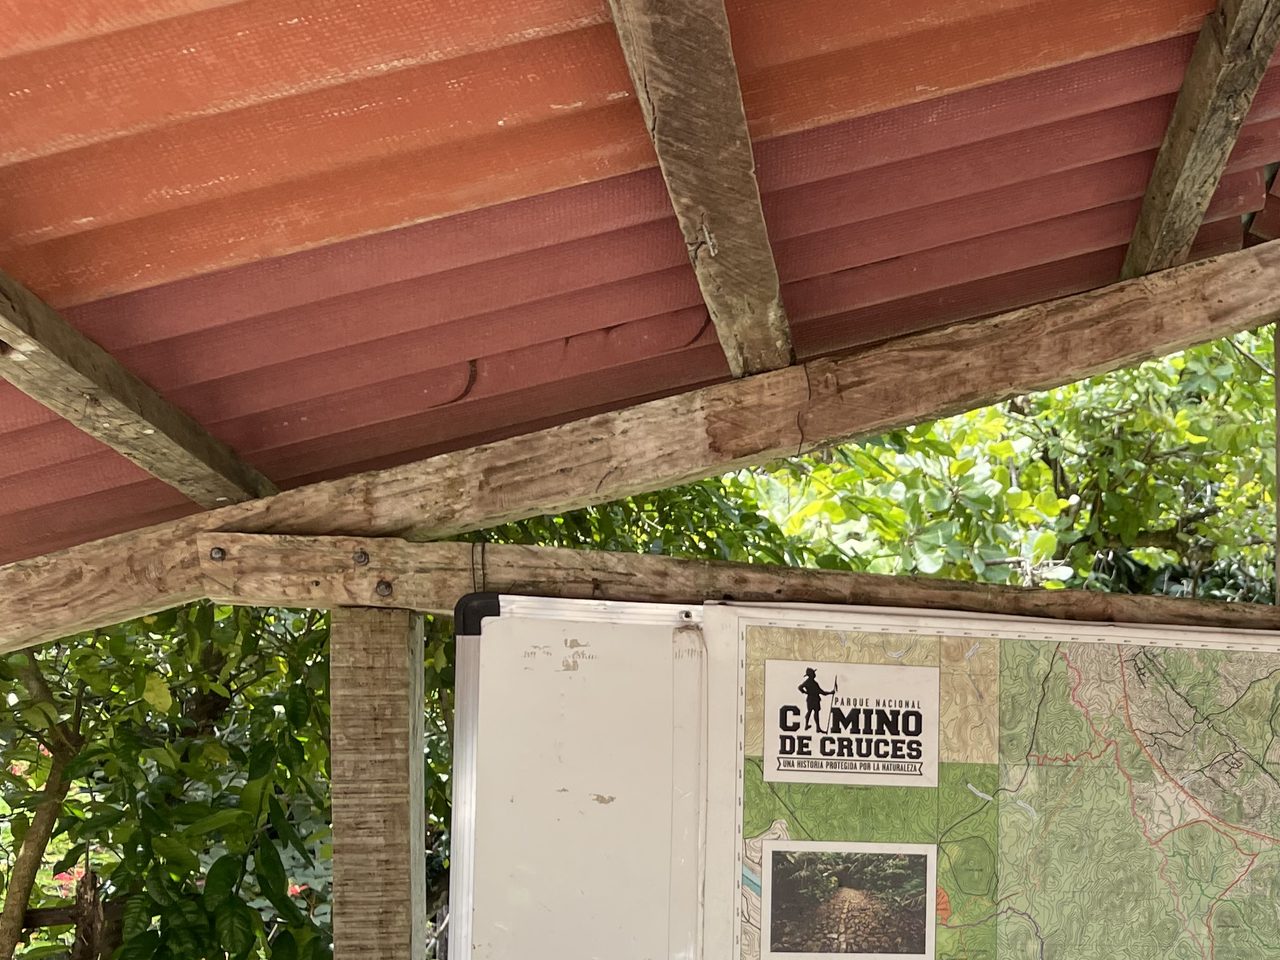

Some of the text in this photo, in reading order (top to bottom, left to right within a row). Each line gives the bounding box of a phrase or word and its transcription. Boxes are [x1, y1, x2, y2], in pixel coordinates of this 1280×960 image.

[834, 698, 921, 709] PARQUE NACIONAL
[779, 735, 922, 759] DE CRUCES
[783, 760, 917, 773] UNA HISTORIA PROTEGIDA POR LA NATURALEZA
